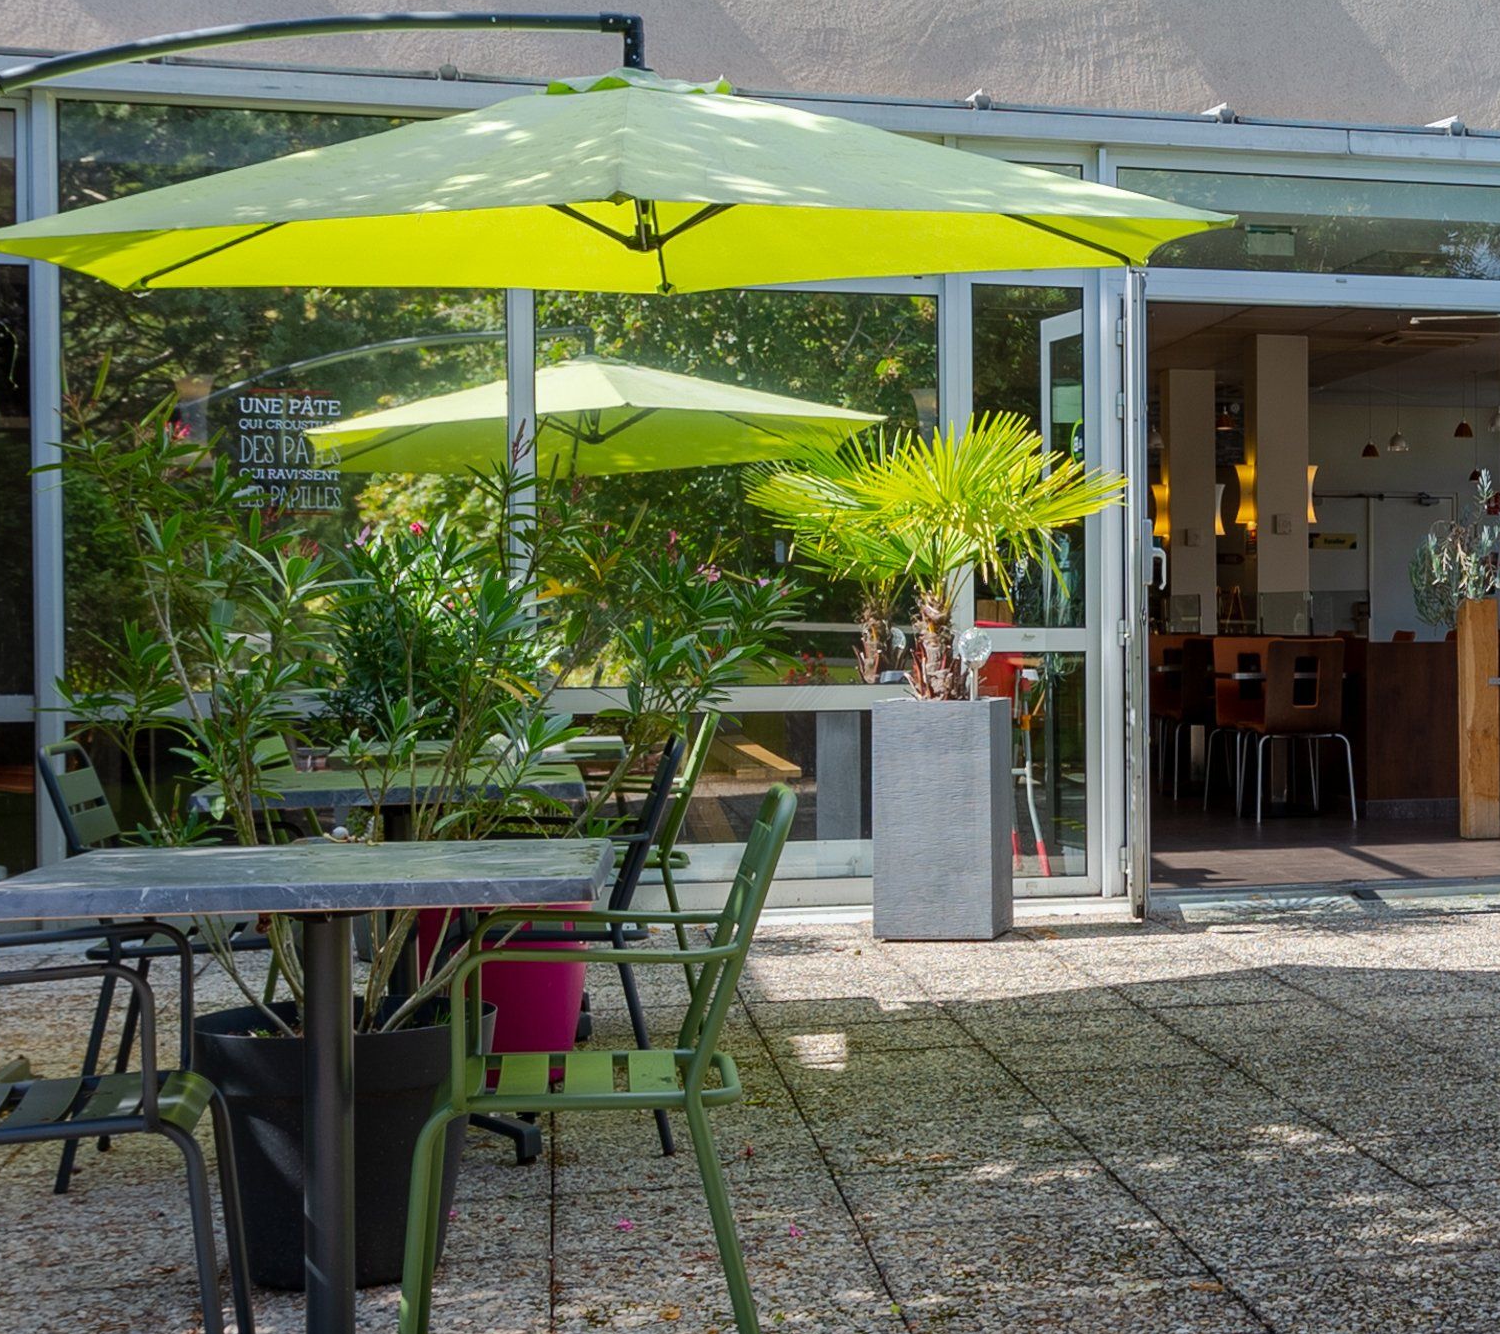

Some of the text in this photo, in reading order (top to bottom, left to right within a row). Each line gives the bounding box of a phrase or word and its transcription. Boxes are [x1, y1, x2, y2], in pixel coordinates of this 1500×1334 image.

[239, 395, 341, 416] UNE PÂTE
[238, 418, 263, 430] QUI
[239, 434, 275, 464] DES
[267, 468, 340, 481] RAVISSENT
[270, 485, 342, 508] PAPILLES
